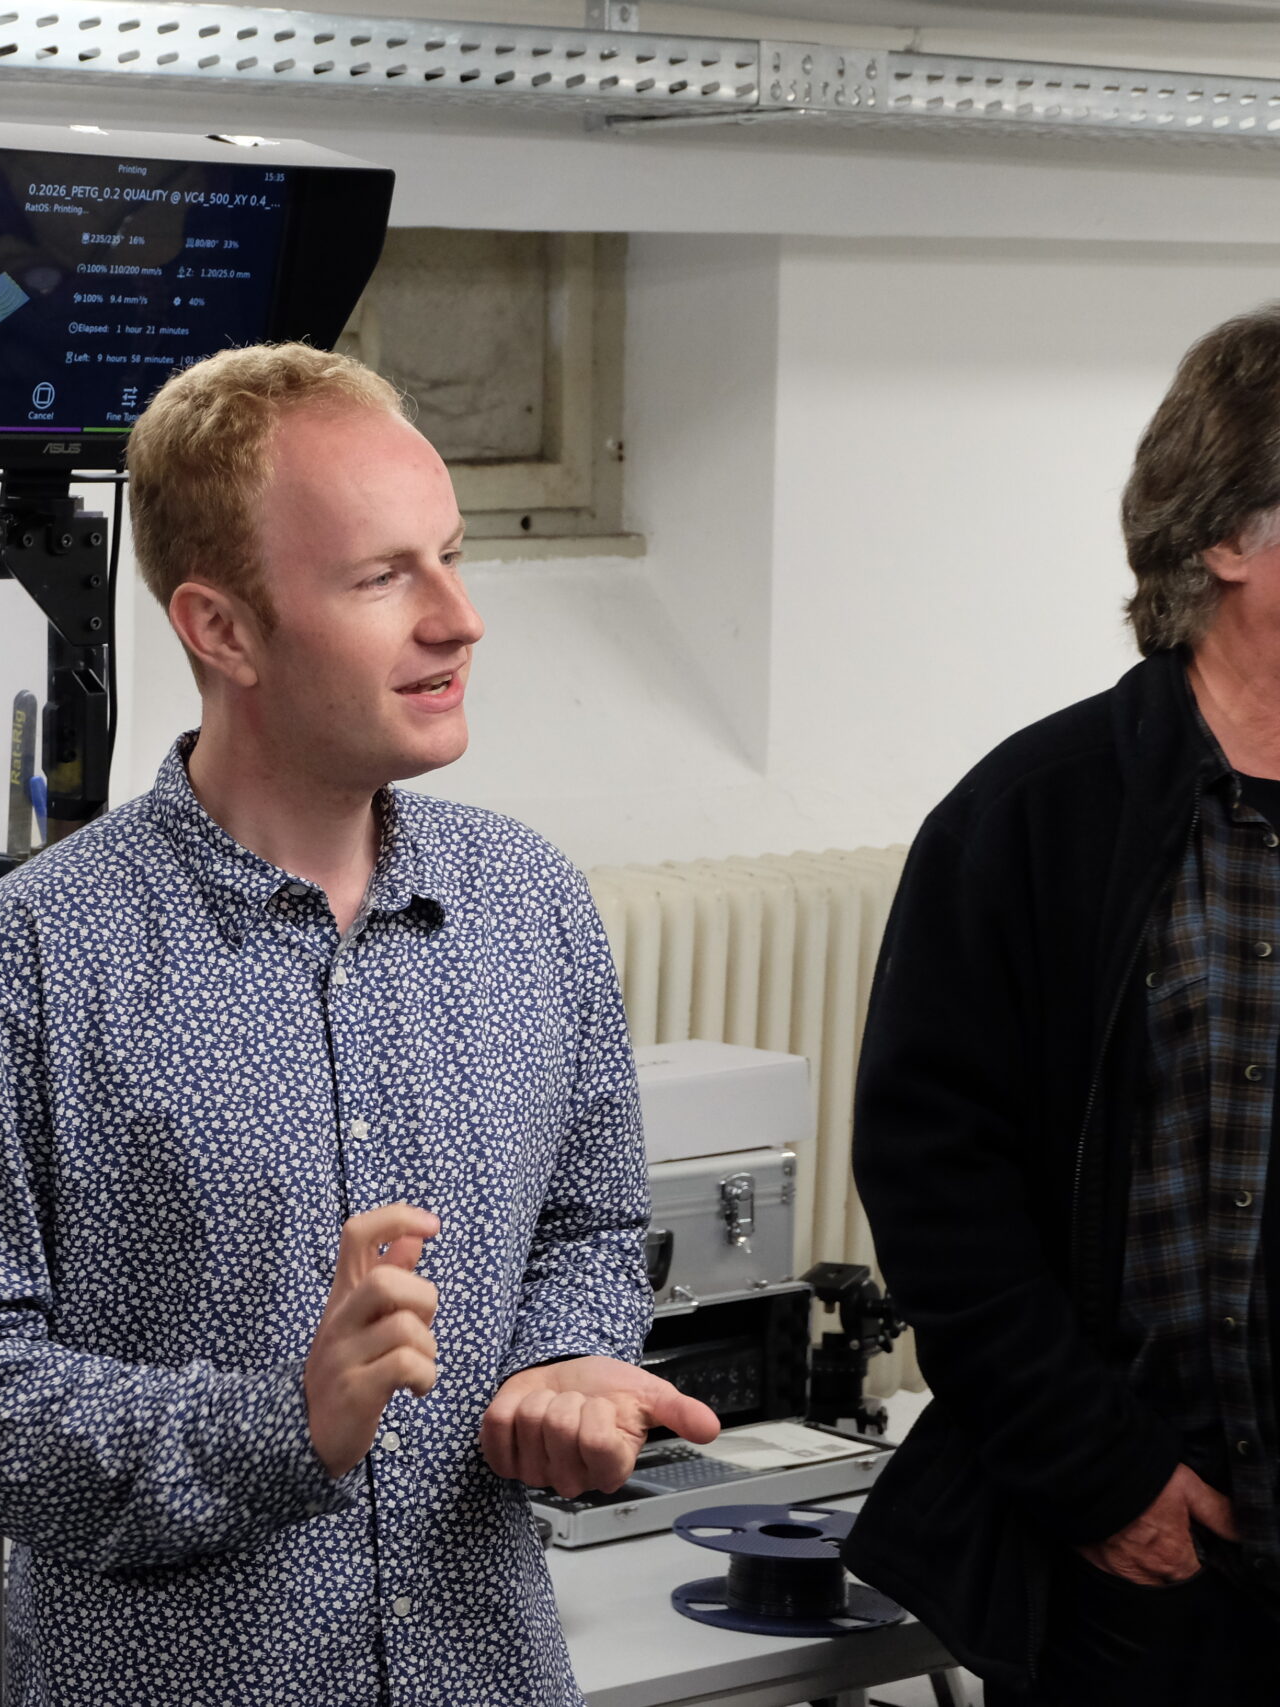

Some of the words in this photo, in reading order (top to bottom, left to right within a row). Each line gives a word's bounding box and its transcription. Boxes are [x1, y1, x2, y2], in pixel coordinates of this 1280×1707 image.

[118, 164, 147, 176] Printing
[265, 172, 285, 182] 15:35
[28, 183, 120, 201] 0.2026_PETG_0.2
[123, 188, 168, 202] QUALITY
[171, 191, 182, 204] @
[184, 191, 248, 208] VC4_500_XY
[25, 202, 51, 213] RatOS:
[53, 205, 89, 216] Printing...
[223, 240, 239, 249] 33%
[87, 264, 107, 274] 100%
[109, 265, 140, 275] 110/200
[141, 267, 162, 276] mm/s
[186, 268, 195, 277] Z:
[236, 271, 251, 279] mm
[83, 294, 103, 304] 100%
[78, 323, 109, 334] Elapsed:
[125, 325, 142, 334] hour
[146, 326, 156, 335] 21
[159, 326, 189, 336] minutes
[74, 353, 90, 362] Left:
[97, 353, 103, 362] 9
[106, 354, 127, 363] hours
[131, 354, 141, 363] 58
[144, 355, 174, 364] minutes
[28, 411, 54, 421] Cancel
[106, 412, 122, 421] Fine
[42, 443, 82, 454] ASUS
[11, 710, 26, 785] Rat-Rig
